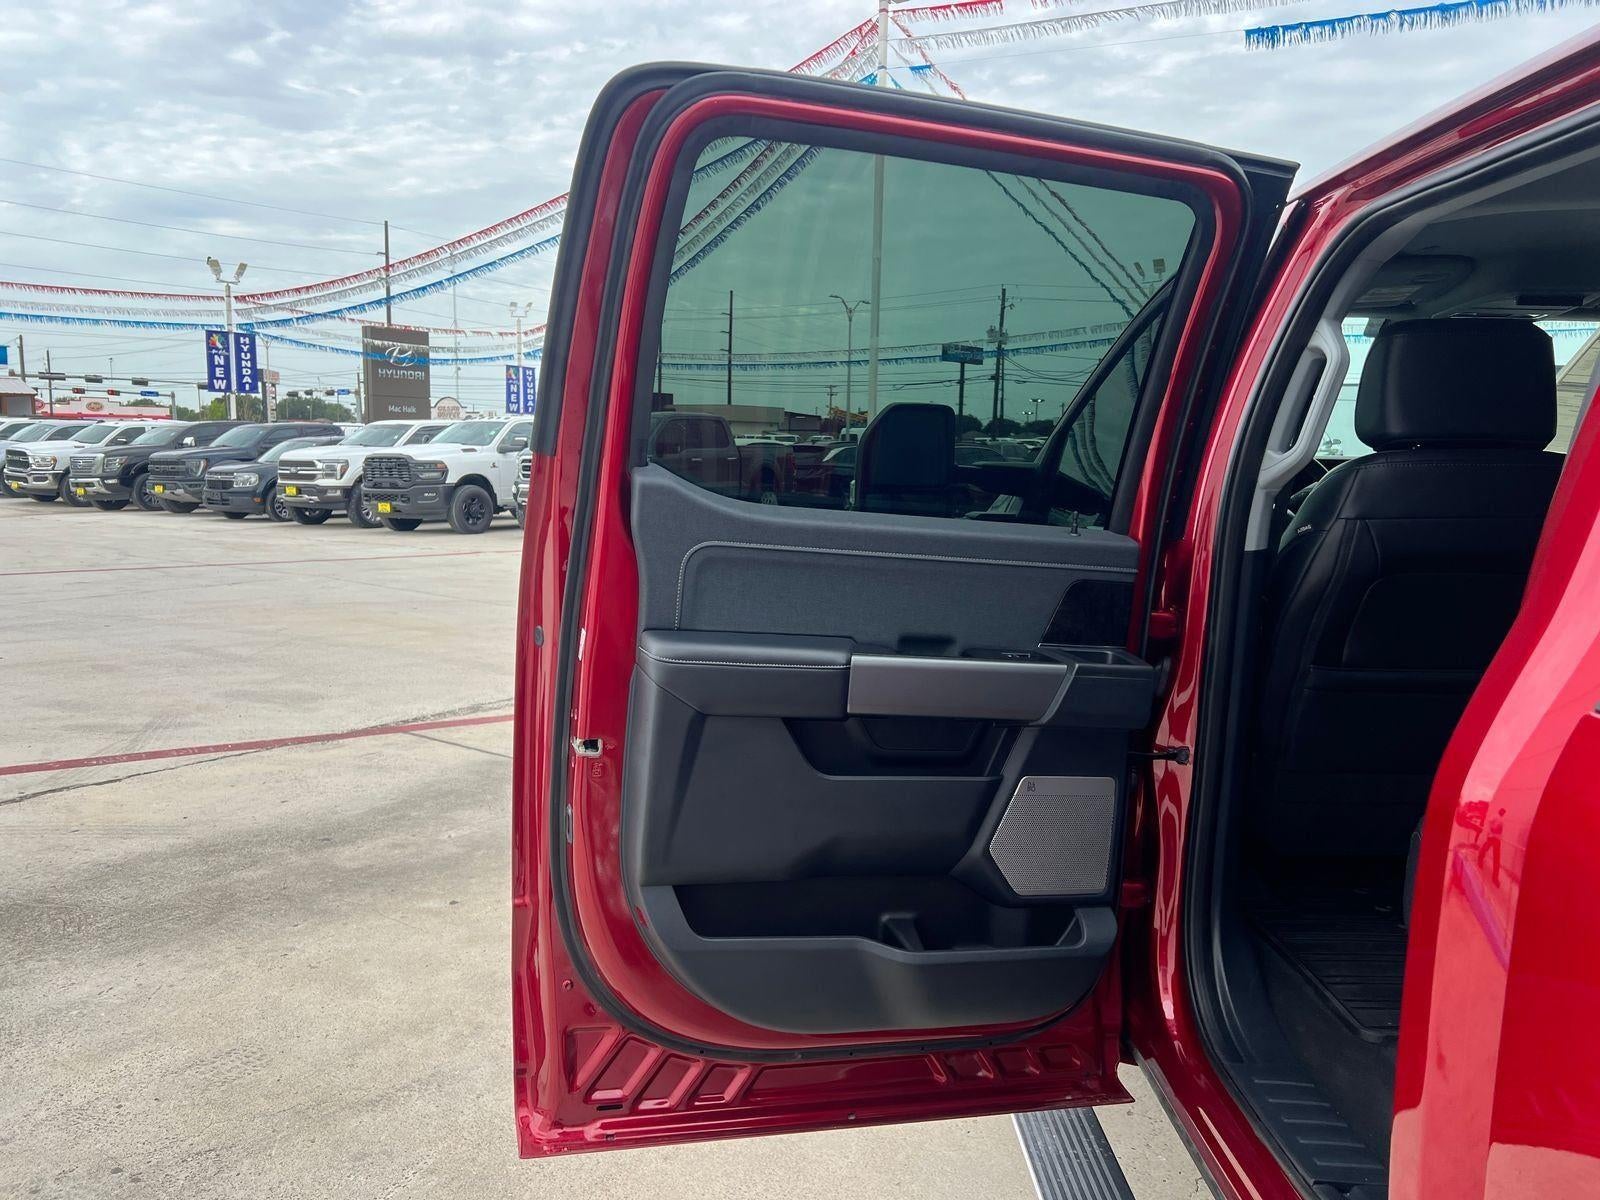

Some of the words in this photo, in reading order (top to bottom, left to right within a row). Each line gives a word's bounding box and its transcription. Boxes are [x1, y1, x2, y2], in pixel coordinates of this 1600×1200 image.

[213, 355, 226, 390] NEW
[240, 336, 252, 391] HYUNDAI
[378, 368, 425, 380] HYUNDAI
[509, 384, 518, 412] NEW
[526, 369, 534, 413] HYUNDAI
[388, 404, 402, 413] Mac
